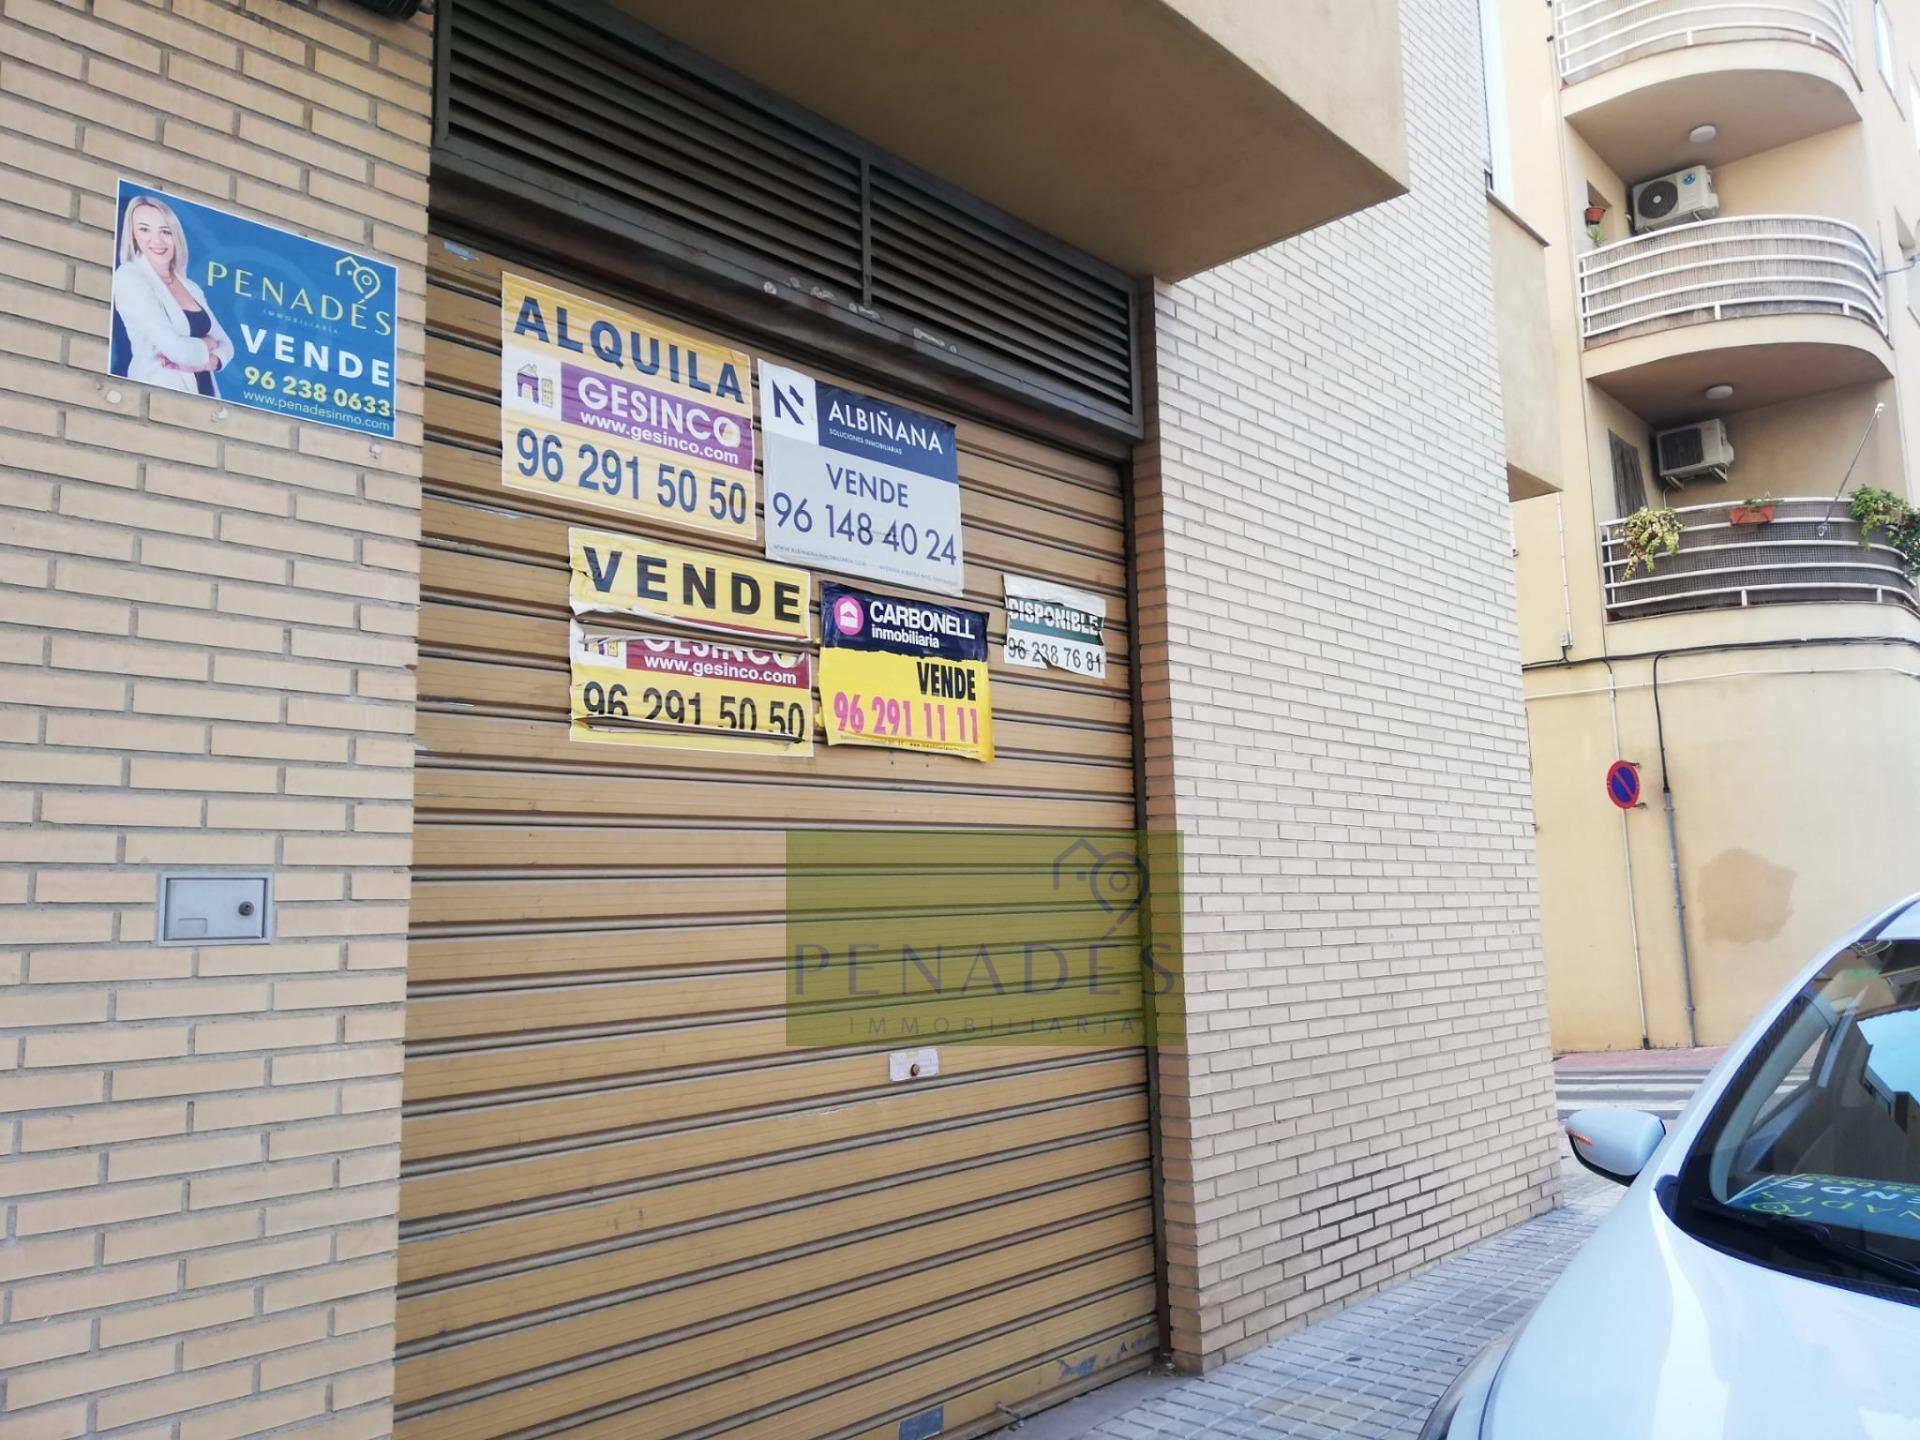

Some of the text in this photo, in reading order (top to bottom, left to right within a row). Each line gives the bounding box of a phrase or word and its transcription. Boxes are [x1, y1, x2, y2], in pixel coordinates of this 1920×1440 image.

[207, 261, 391, 336] PENADÉS
[240, 323, 390, 388] VENDE
[513, 295, 744, 404] ALQUILA
[243, 389, 390, 431] www.penadesinmo.com
[244, 366, 391, 417] 96 238 0633
[578, 376, 741, 448] GESINCO
[580, 411, 738, 464] www.gesinco.com
[828, 400, 943, 455] ALBIÑANA
[517, 428, 746, 524] 96 291 50 50
[825, 463, 908, 508] VENDE
[773, 492, 956, 565] 96 148 40 24
[583, 546, 800, 623] VENDE
[870, 601, 975, 640] CARBONELL
[871, 624, 940, 649] inmobiliaria
[1008, 598, 1100, 636] DISPONIBLE
[644, 656, 797, 685] www.gesinco.com
[917, 661, 976, 701] VENDE
[1008, 637, 1026, 661] 96
[1063, 647, 1081, 668] 76
[1086, 651, 1102, 673] 81
[583, 682, 805, 743] 96 291 50 50
[834, 691, 865, 733] 96
[872, 696, 912, 737] 291
[924, 703, 946, 741] 11
[957, 707, 978, 745] 11
